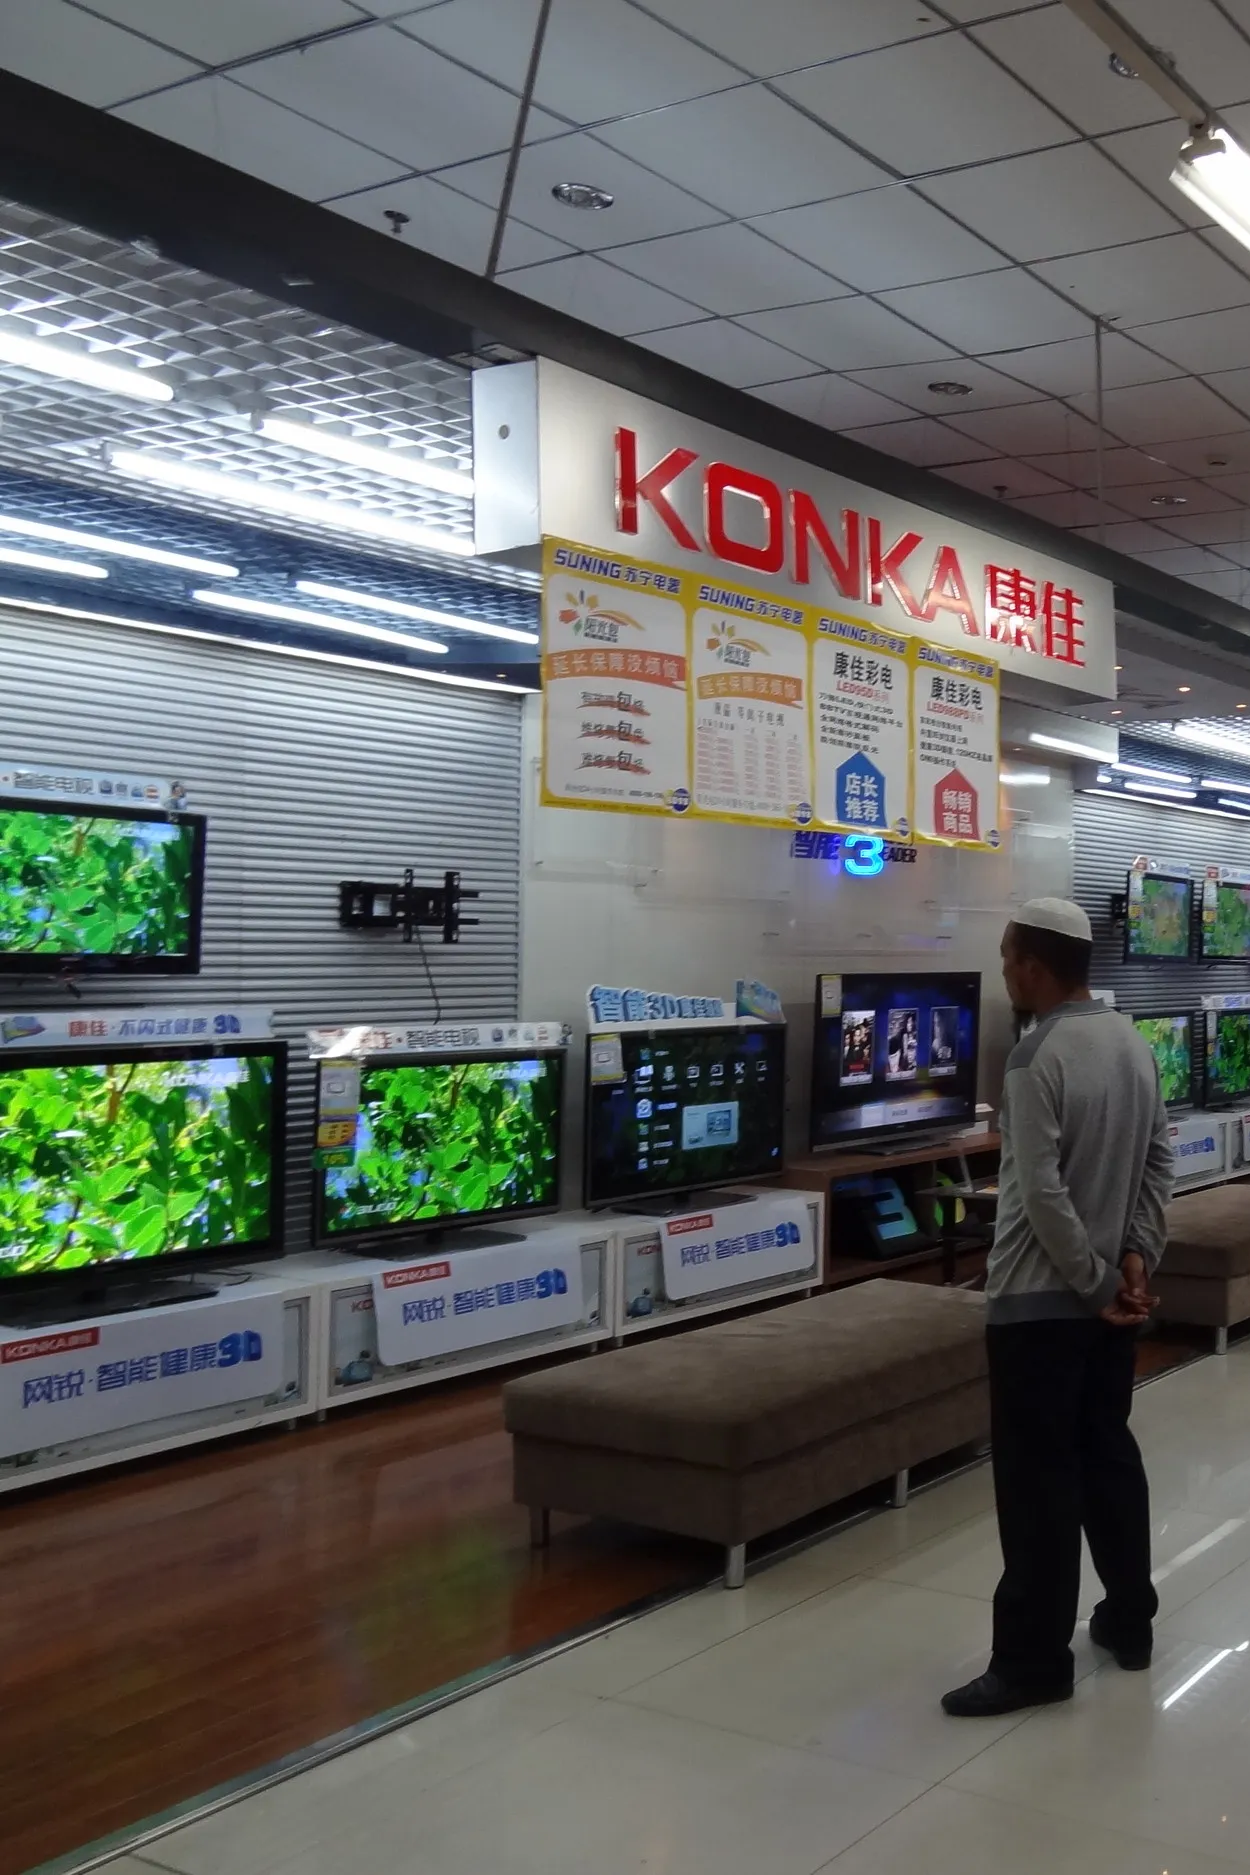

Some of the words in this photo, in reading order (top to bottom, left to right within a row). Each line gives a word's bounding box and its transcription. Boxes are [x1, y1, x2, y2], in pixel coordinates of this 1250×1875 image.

[614, 426, 980, 638] KONKA
[983, 563, 1086, 668] 康佳
[554, 549, 622, 579] SUNING
[624, 566, 681, 594] 苏宁电器
[699, 585, 756, 612] SUNING
[757, 600, 804, 625] 苏宁电器
[818, 618, 868, 642] SUNING
[552, 652, 680, 680] 延长保障没烦恼
[833, 651, 893, 690] 康佳彩电
[931, 676, 983, 710] 康佳彩电
[845, 773, 878, 798] 店长
[845, 796, 879, 822] 推荐
